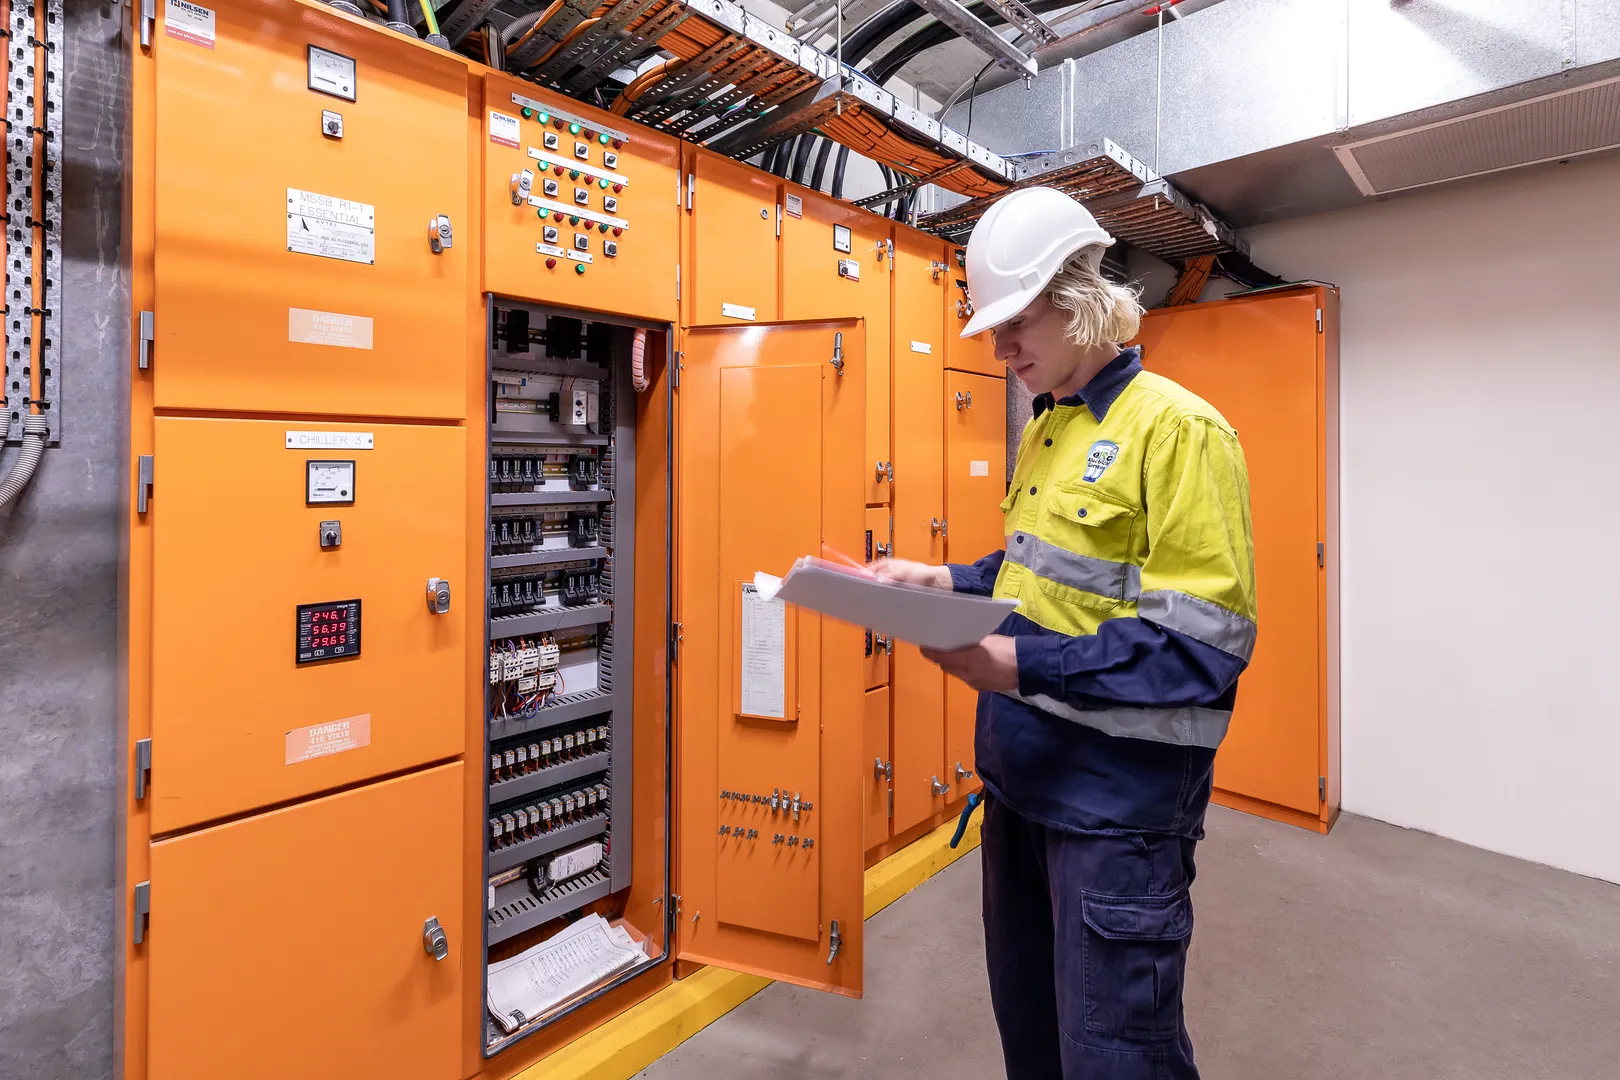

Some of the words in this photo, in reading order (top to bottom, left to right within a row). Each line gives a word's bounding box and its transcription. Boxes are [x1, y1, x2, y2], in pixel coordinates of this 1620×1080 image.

[181, 2, 209, 16] NILSEN
[499, 114, 516, 124] NILSEN
[300, 191, 333, 207] MSSB
[339, 200, 363, 213] R1-1
[299, 204, 363, 225] ESSENTIAL
[312, 314, 353, 327] DANGER
[299, 434, 348, 445] CHILLER
[354, 435, 362, 446] 3
[312, 609, 347, 622] 246.1
[312, 622, 347, 635] 56.39
[311, 635, 346, 648] 29.65
[309, 721, 350, 738] DANGER
[327, 729, 350, 741] VOLTS
